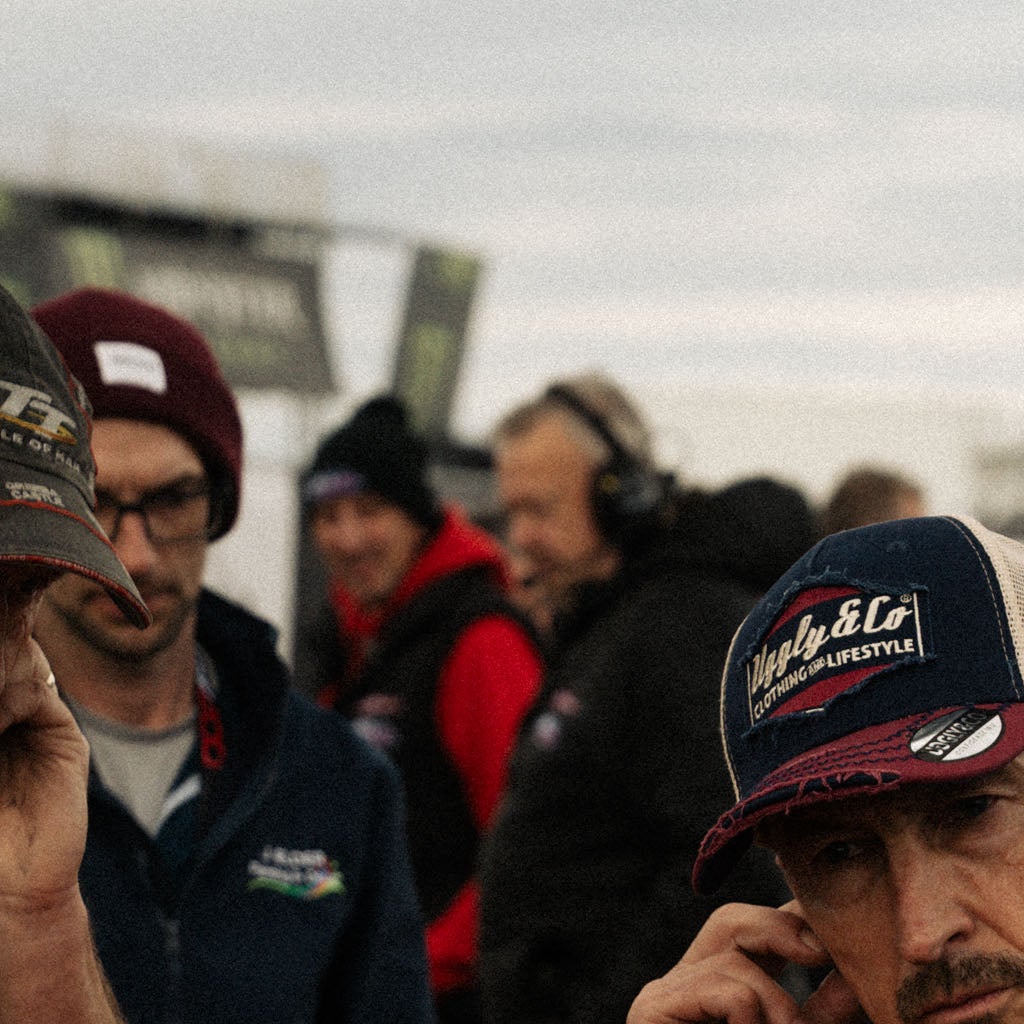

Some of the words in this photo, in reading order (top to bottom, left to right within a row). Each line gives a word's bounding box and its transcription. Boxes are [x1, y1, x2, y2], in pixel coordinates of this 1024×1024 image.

[0, 380, 77, 433] TT
[0, 428, 23, 445] LE
[29, 438, 52, 453] OF
[753, 665, 808, 719] CLOTHING
[826, 638, 915, 668] LIFESTYLE
